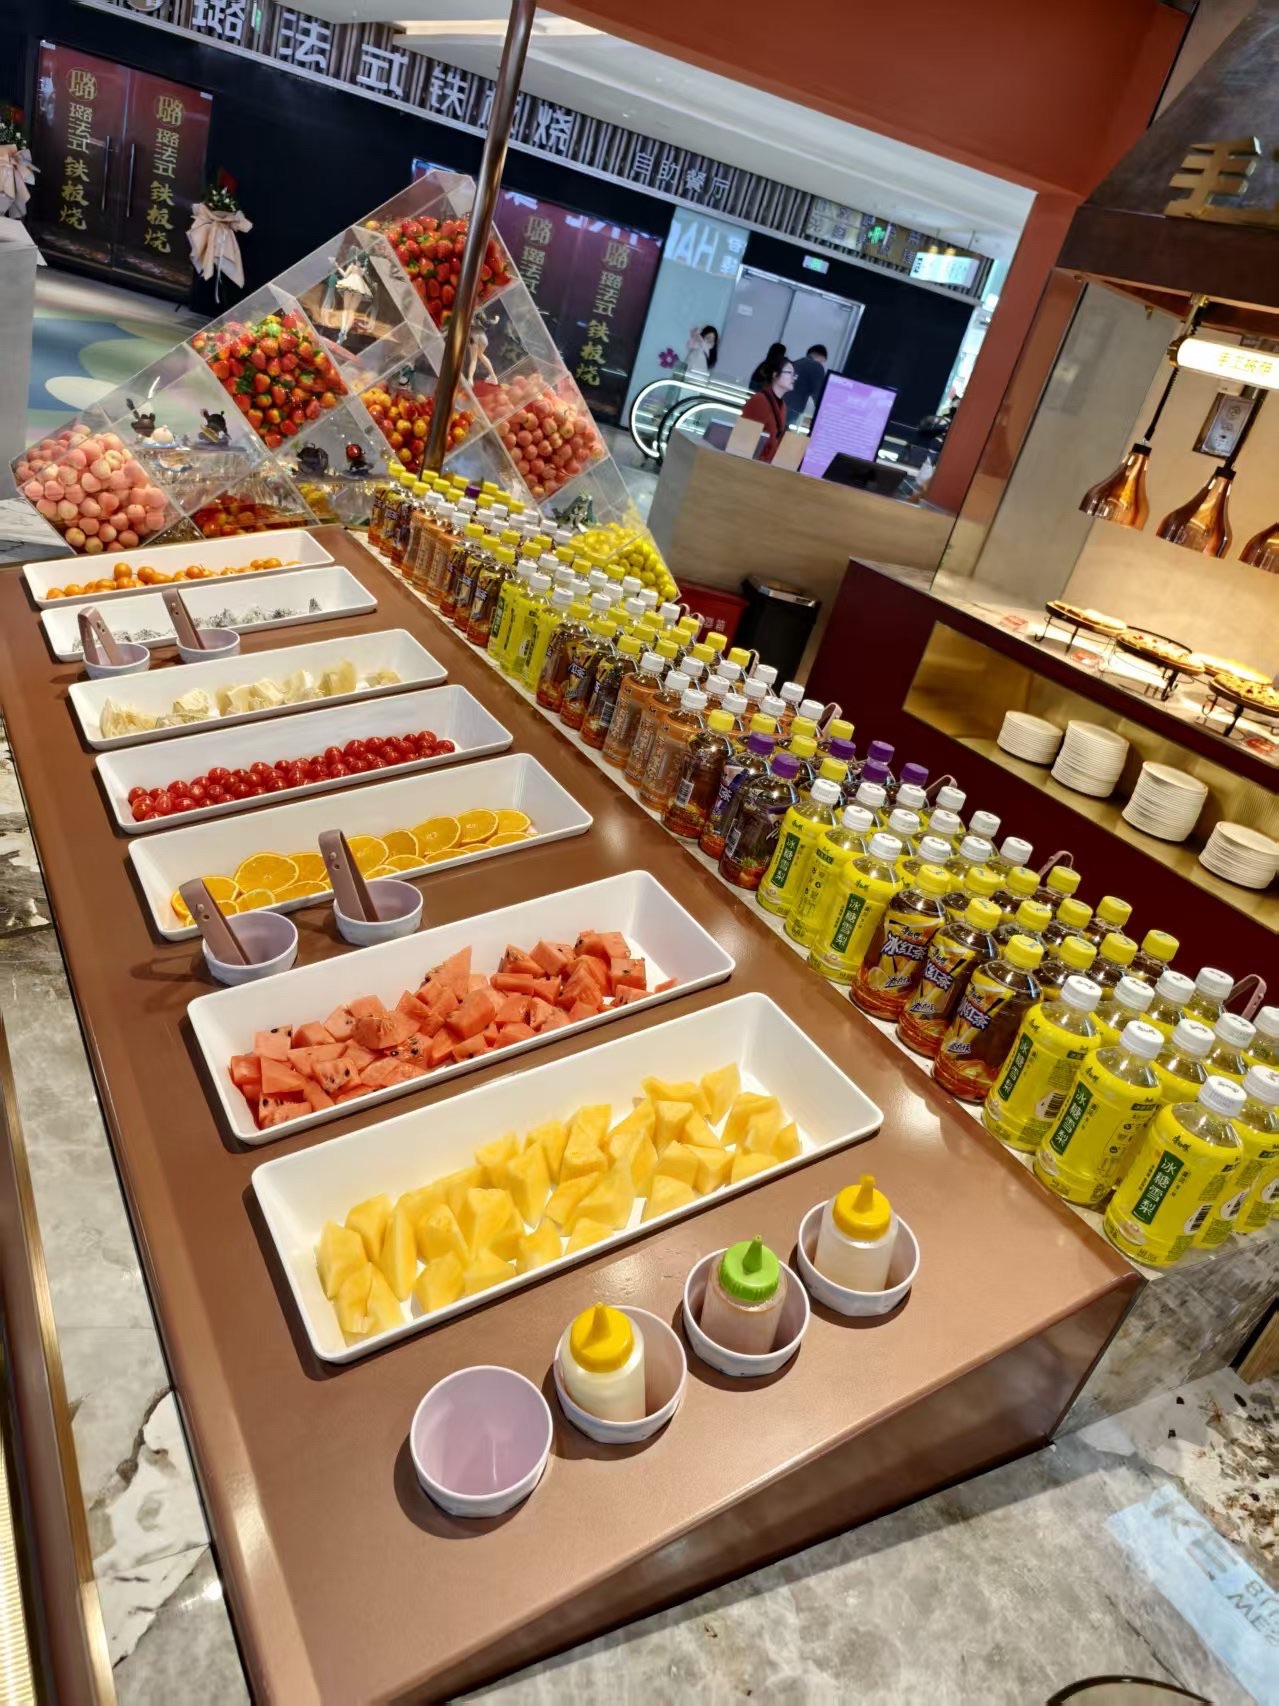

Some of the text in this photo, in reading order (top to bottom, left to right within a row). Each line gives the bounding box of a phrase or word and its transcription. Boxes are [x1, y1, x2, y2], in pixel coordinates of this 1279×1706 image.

[631, 151, 729, 200] 自助餐厅
[880, 931, 928, 960] 冰红茶
[925, 959, 953, 990] 红茶
[1138, 1157, 1178, 1217] 冰糖雪梨
